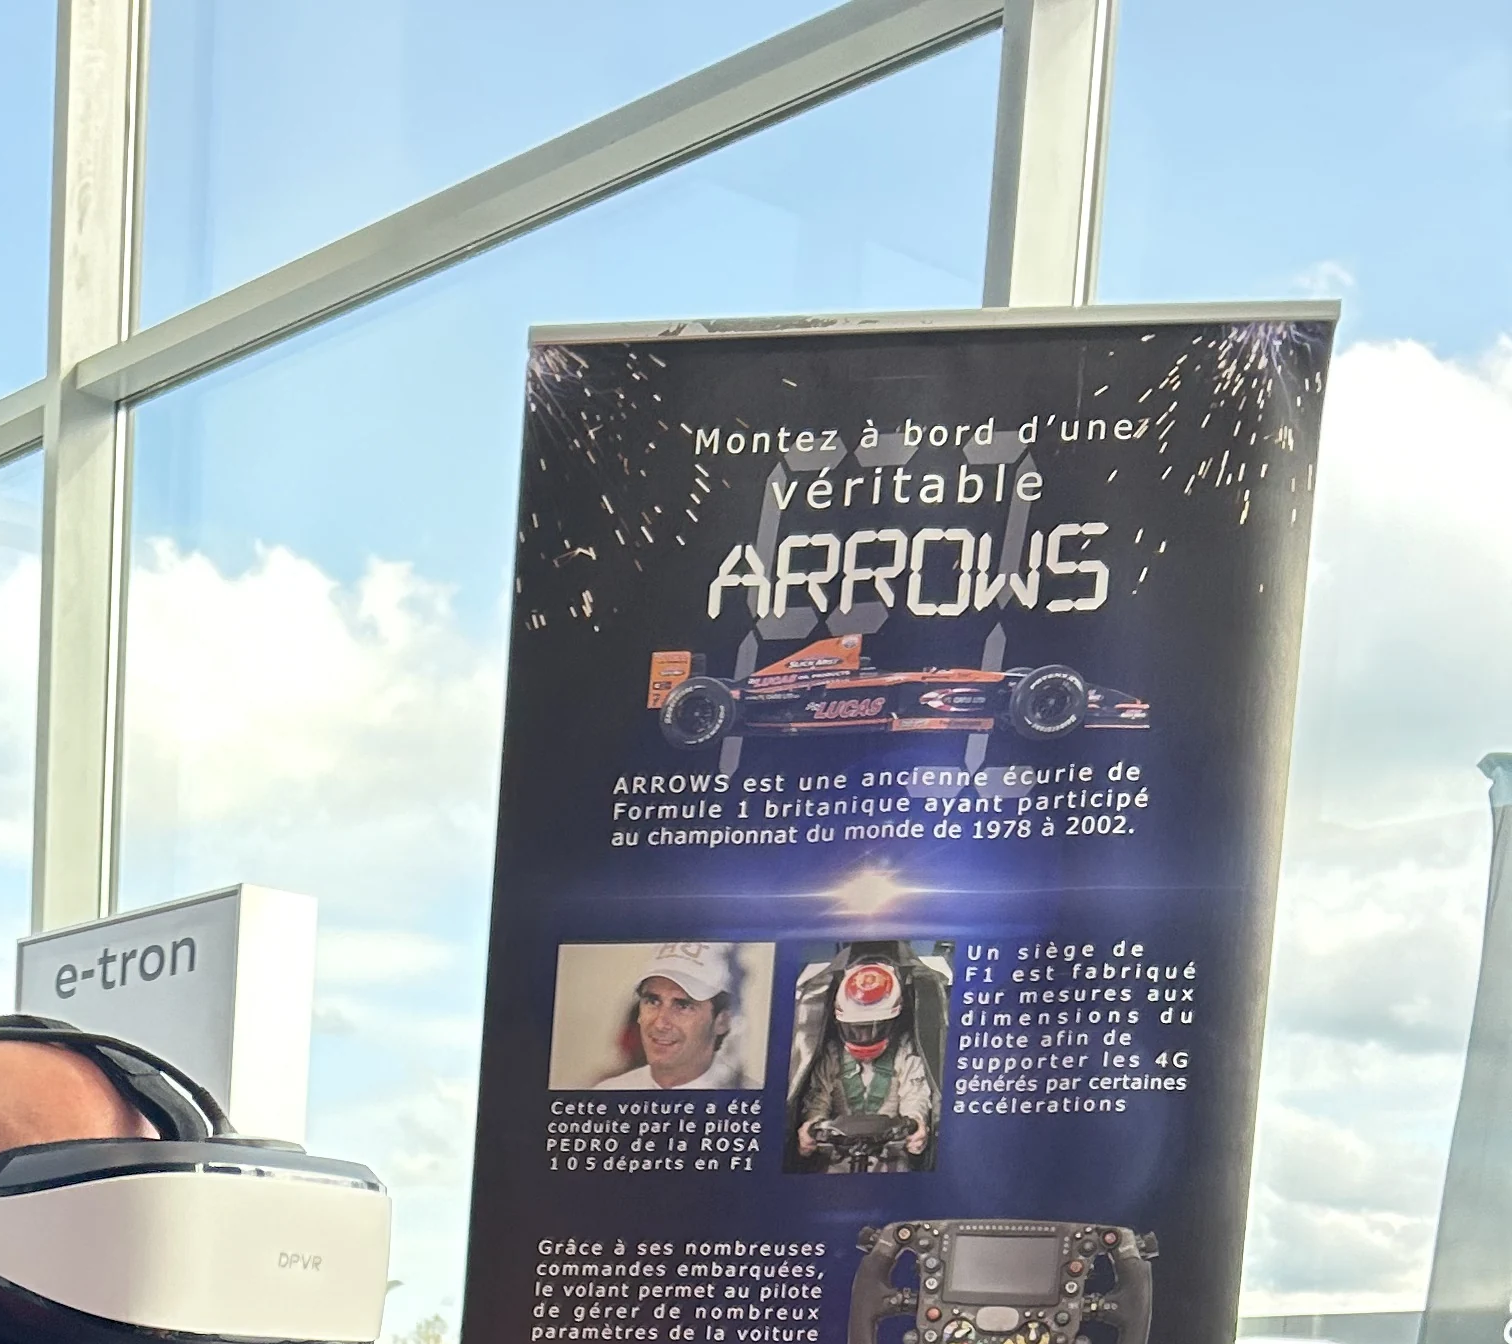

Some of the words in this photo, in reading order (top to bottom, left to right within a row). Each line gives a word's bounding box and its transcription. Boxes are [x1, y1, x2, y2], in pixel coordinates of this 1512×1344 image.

[696, 427, 837, 454] Montez
[860, 419, 878, 448] à
[904, 418, 993, 451] bord
[772, 463, 1042, 510] véritable
[708, 522, 1109, 619] ARROWS
[814, 698, 886, 719] LUCAS
[614, 774, 731, 795] ARROWS
[744, 775, 784, 792] est
[800, 775, 846, 791] une
[862, 766, 990, 787] ancienne
[1003, 764, 1092, 786] écurie
[1108, 762, 1140, 781] de
[614, 800, 721, 820] Formule
[738, 801, 748, 818] 1
[766, 794, 910, 817] britanique
[925, 795, 1003, 816] ayant
[1018, 785, 1148, 814] participé
[612, 832, 638, 846] au
[648, 826, 798, 848] championnat
[807, 824, 834, 842] du
[845, 819, 924, 840] monde
[934, 820, 961, 838] de
[973, 820, 1031, 838] 1978
[1041, 817, 1054, 836] à
[1066, 816, 1134, 834] 2002.
[968, 945, 999, 960] Un
[1018, 942, 1094, 961] siège
[1113, 940, 1143, 957] de
[56, 937, 195, 999] e-tron
[966, 967, 992, 982] F1
[1013, 966, 1054, 982] est
[1073, 962, 1195, 982] fabriqué
[963, 992, 1004, 1004] sur
[1020, 989, 1131, 1003] mesures
[1148, 989, 1193, 1001] aux
[961, 1009, 1138, 1025] dimensions
[1161, 1007, 1192, 1023] du
[960, 1032, 1028, 1050] pilote
[1041, 1030, 1088, 1047] afin
[1104, 1029, 1131, 1045] de
[957, 1054, 1088, 1073] supporter
[1103, 1051, 1139, 1067] les
[1155, 1052, 1188, 1068] 4G
[956, 1074, 1037, 1094] générés
[1046, 1078, 1081, 1093] par
[1089, 1074, 1186, 1090] certaines
[551, 1102, 607, 1114] Cette
[618, 1101, 694, 1114] voiture
[706, 1104, 716, 1114] a
[728, 1099, 761, 1114] été
[954, 1097, 1126, 1113] accélerations
[548, 1120, 630, 1133] conduite
[639, 1122, 671, 1136] par
[679, 1119, 696, 1132] le
[705, 1120, 761, 1135] pilote
[547, 1139, 618, 1152] PEDRO
[631, 1138, 655, 1151] de
[669, 1138, 687, 1151] la
[701, 1138, 759, 1151] ROSA
[604, 1156, 683, 1173] départs
[695, 1159, 718, 1170] en
[731, 1157, 752, 1170] F1
[539, 1239, 602, 1255] Grâce
[614, 1239, 625, 1255] à
[638, 1243, 673, 1255] ses
[686, 1241, 824, 1256] nombreuses
[278, 1252, 323, 1271] DPVR
[537, 1261, 666, 1276] commandes
[677, 1261, 823, 1280] embarquées,
[536, 1282, 553, 1296] le
[563, 1282, 629, 1297] volant
[639, 1284, 714, 1300] permet
[725, 1287, 749, 1298] au
[760, 1284, 821, 1302] pilote
[534, 1303, 559, 1317] de
[574, 1302, 640, 1322] gérer
[654, 1304, 680, 1319] de
[696, 1304, 818, 1320] nombreux
[532, 1324, 657, 1341] paramètres
[670, 1325, 694, 1340] de
[707, 1326, 724, 1340] la
[737, 1326, 818, 1341] voiture
